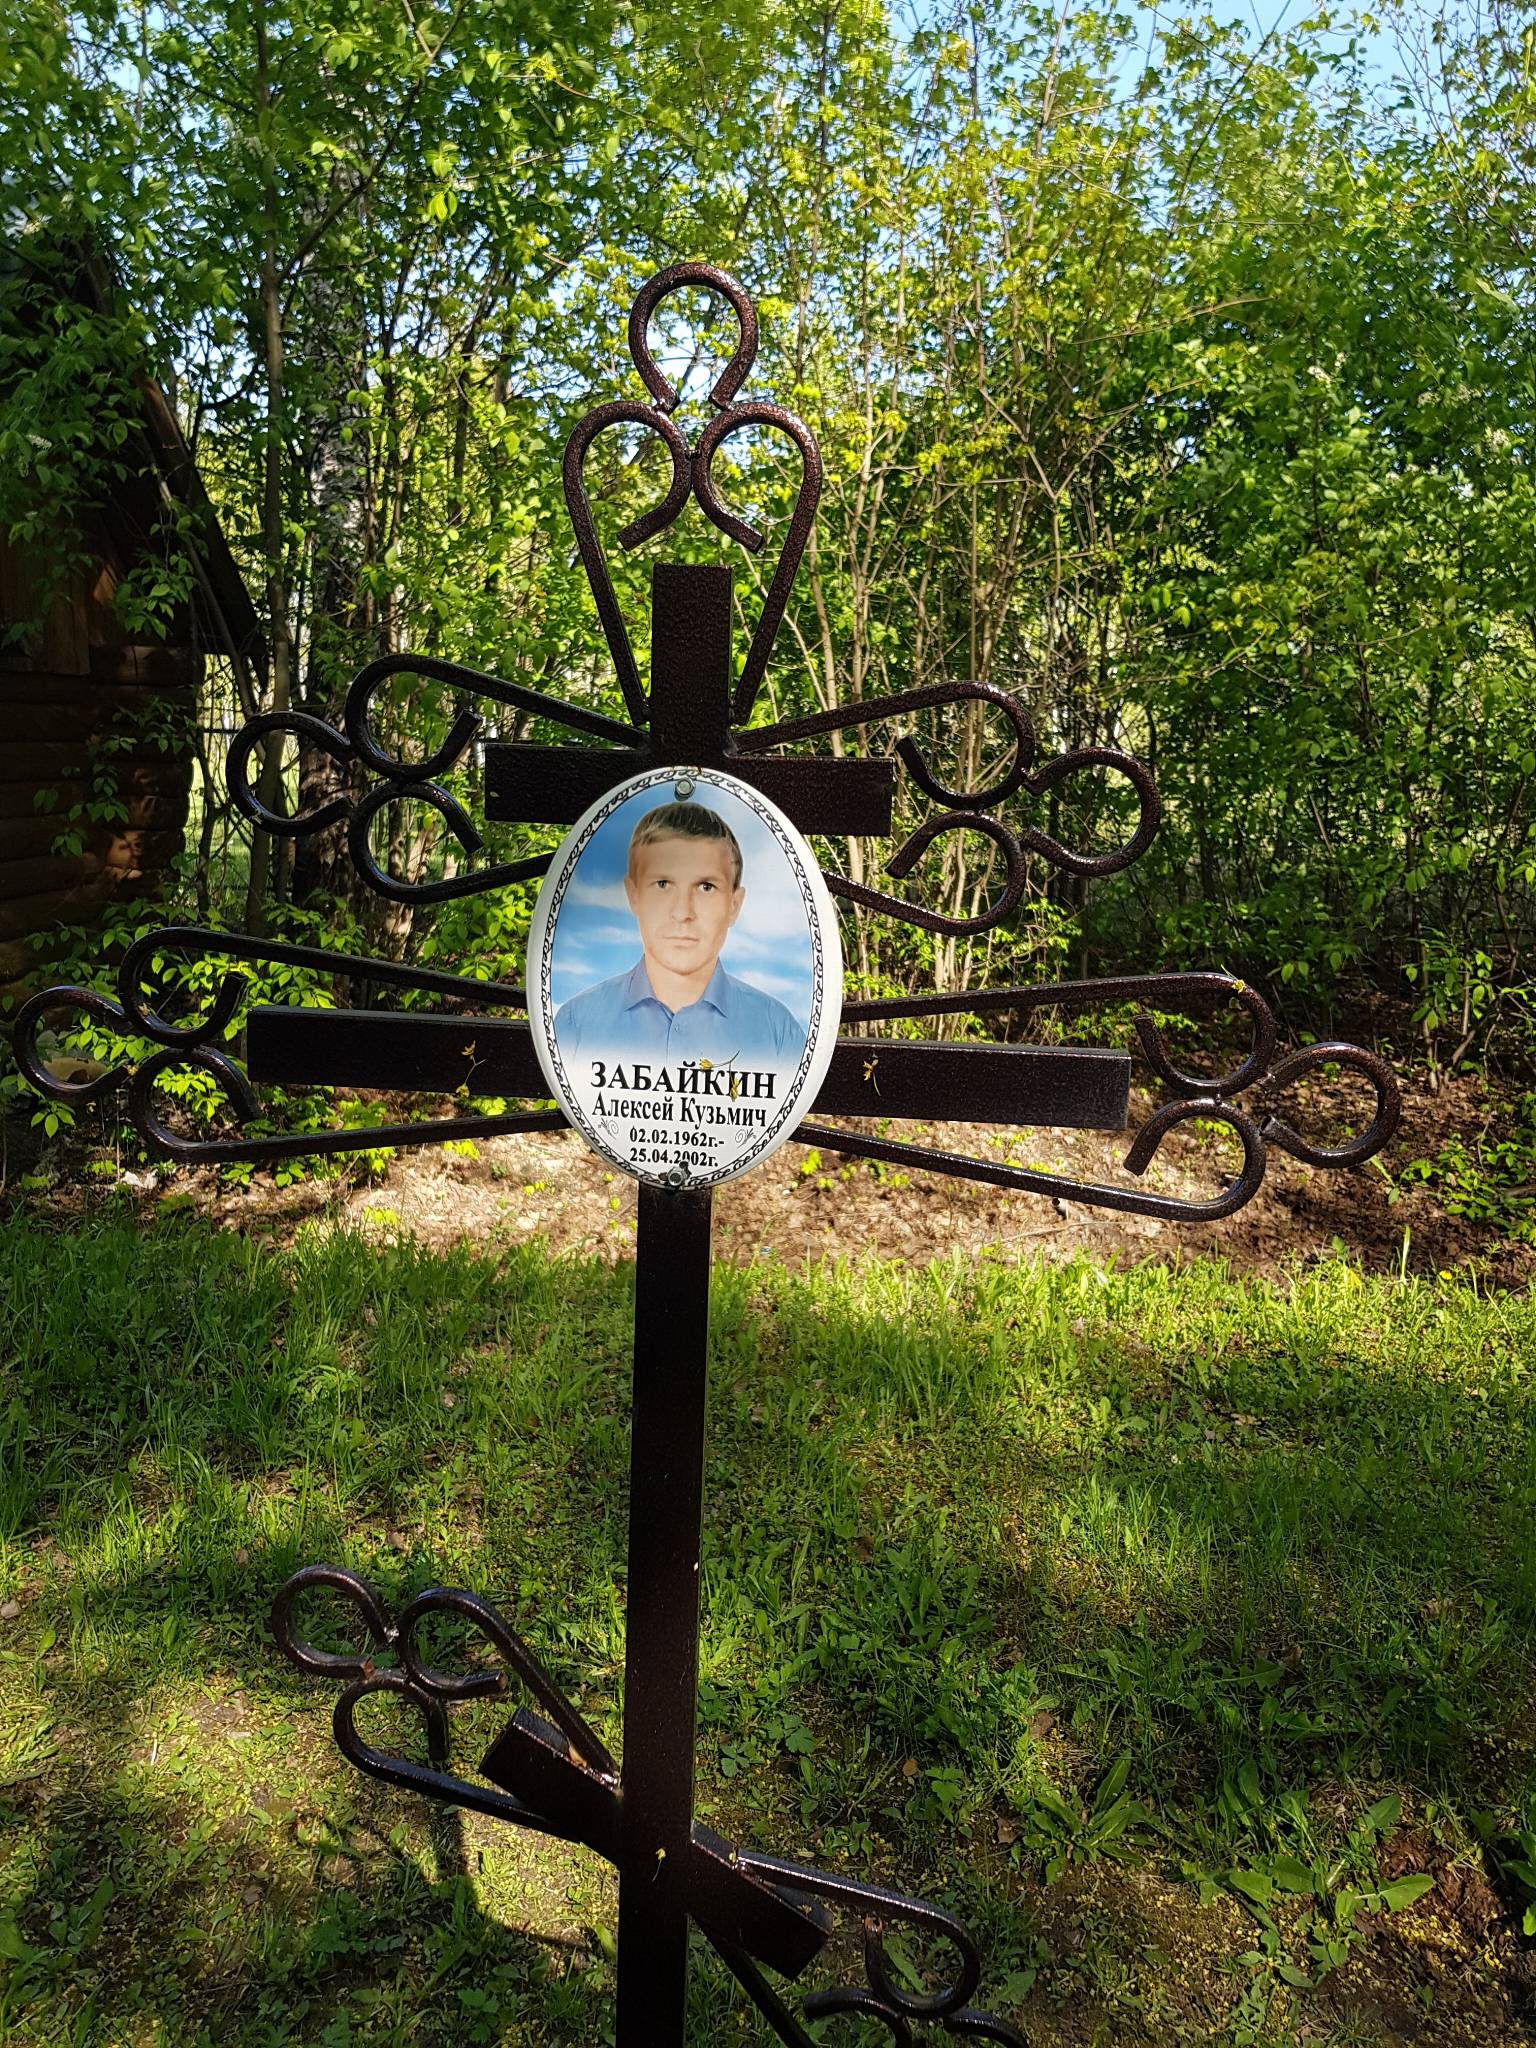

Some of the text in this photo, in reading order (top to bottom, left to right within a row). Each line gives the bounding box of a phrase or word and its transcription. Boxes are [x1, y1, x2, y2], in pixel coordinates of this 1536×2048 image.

[590, 1060, 777, 1099] ЗАБАЙКИН
[592, 1093, 767, 1130] Алексей Кузьмич
[629, 1147, 719, 1167] 25.04.2002г.
